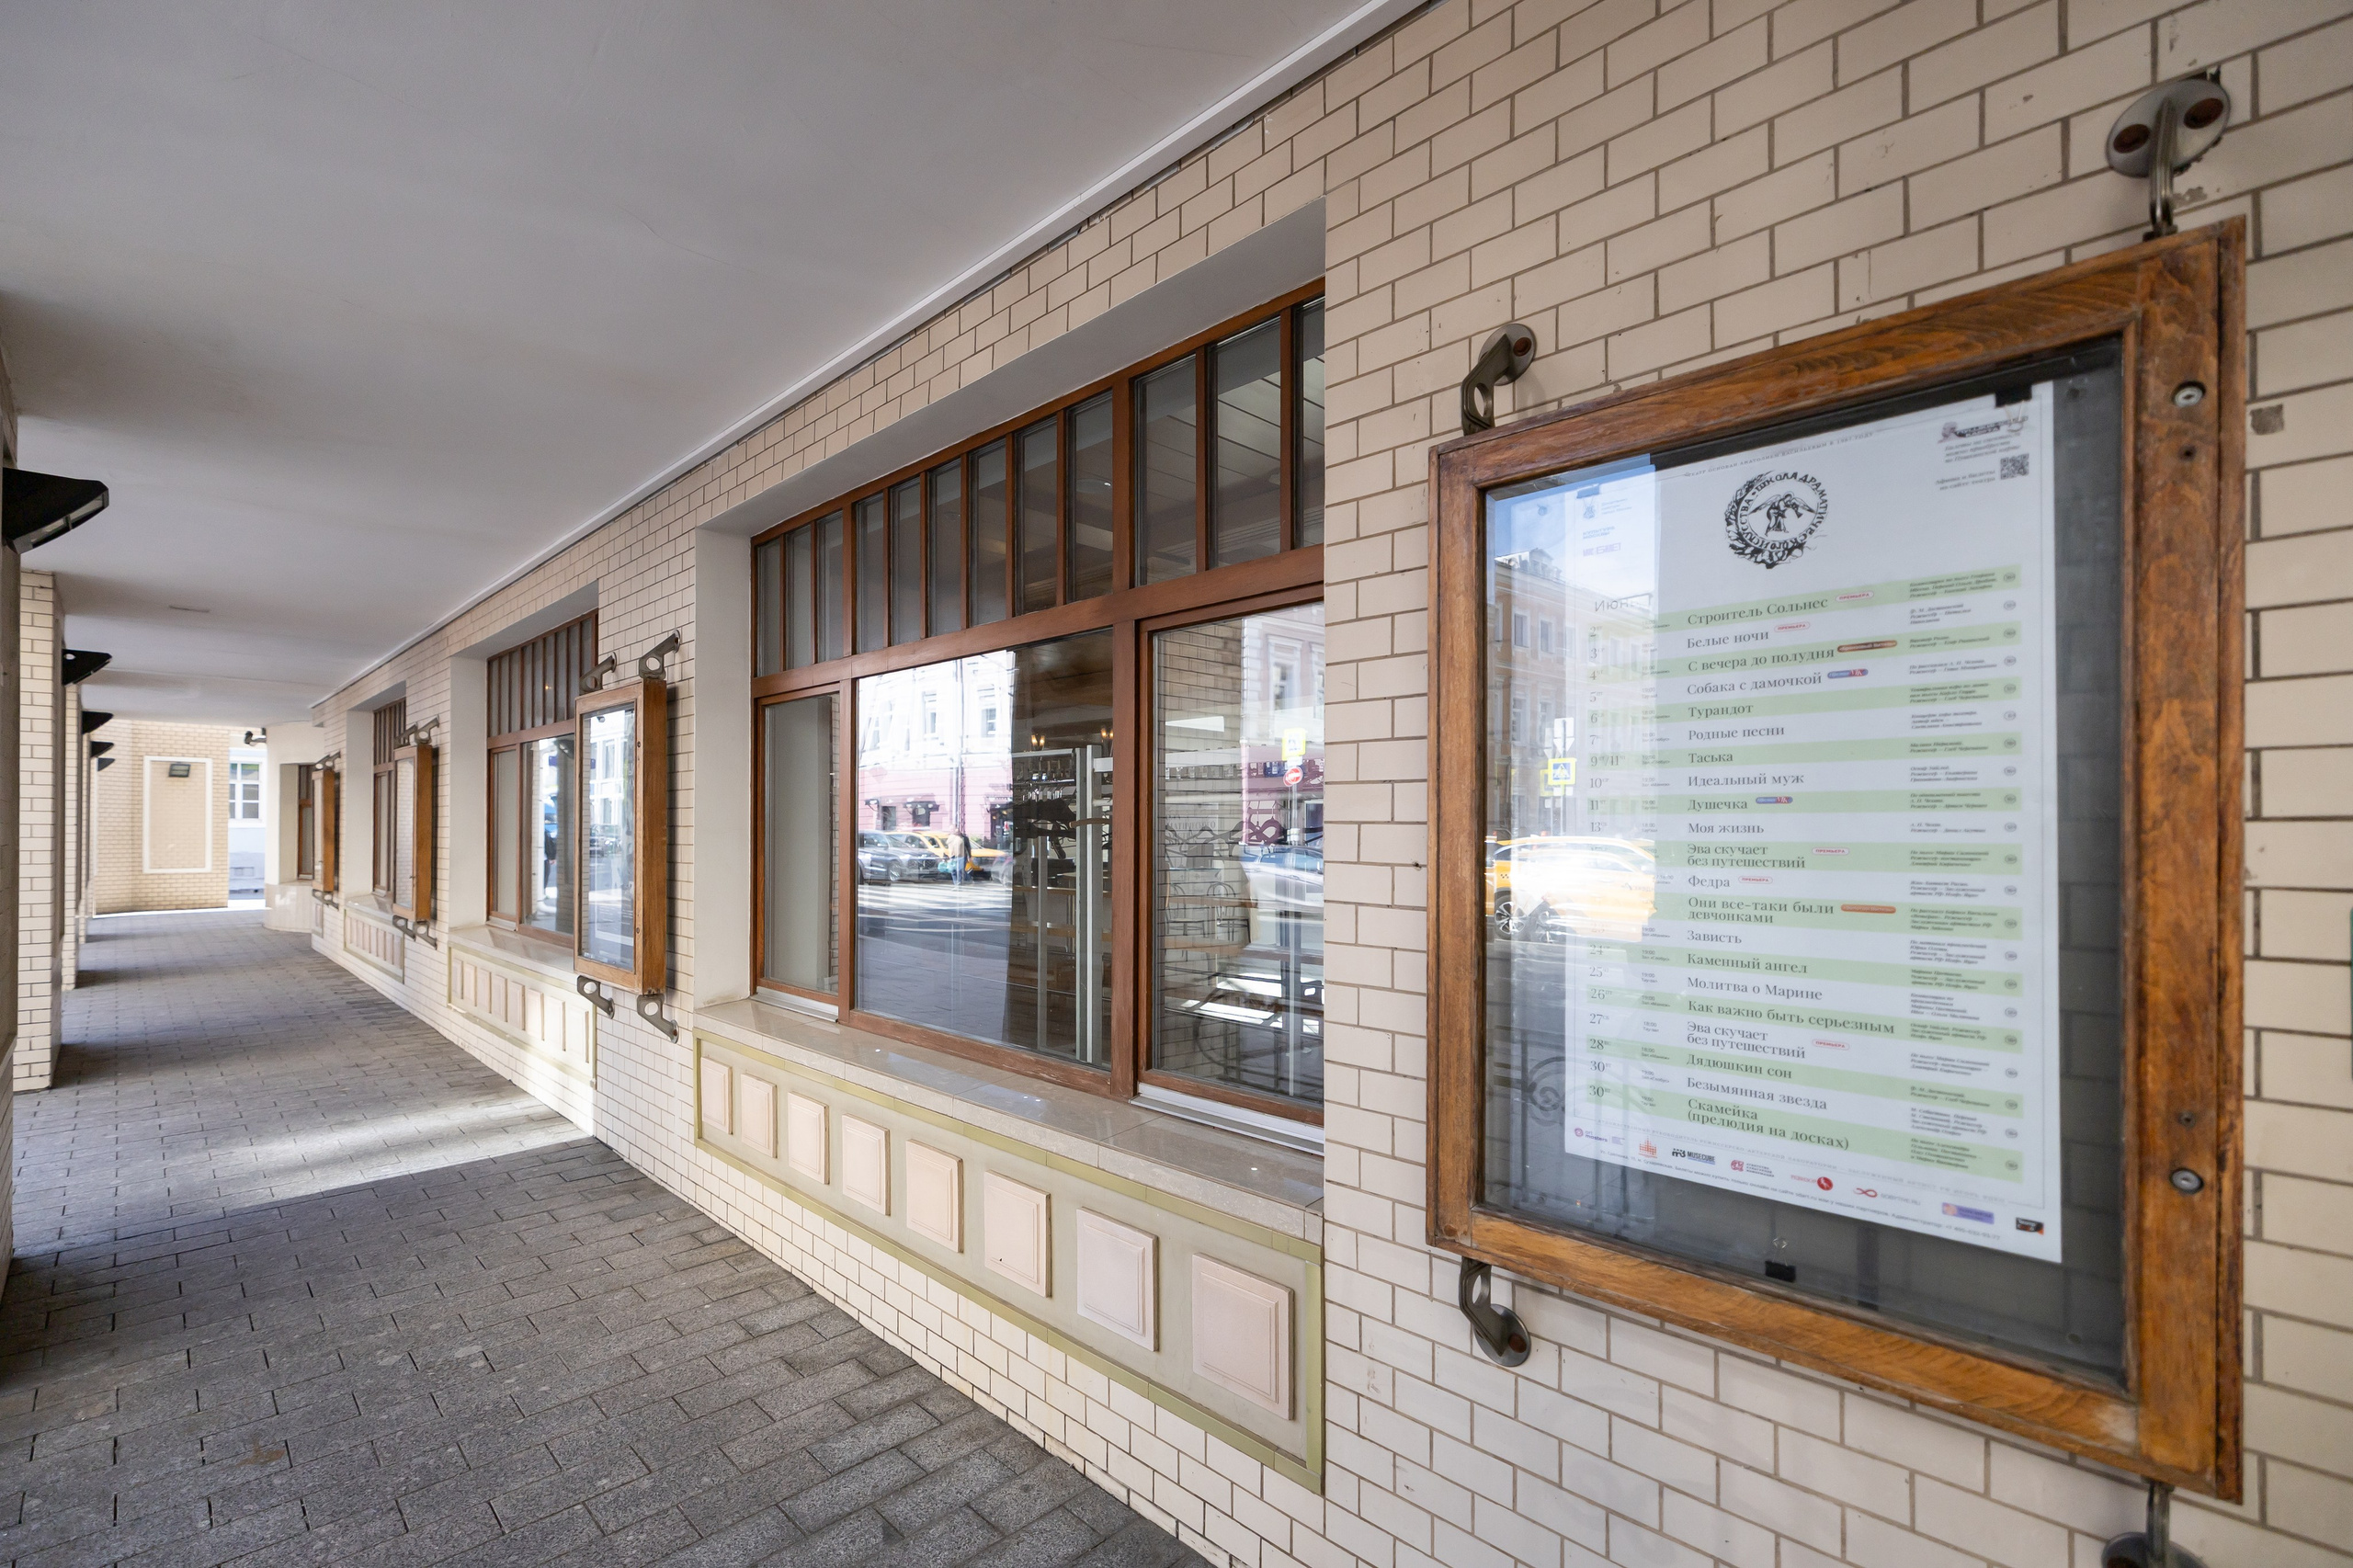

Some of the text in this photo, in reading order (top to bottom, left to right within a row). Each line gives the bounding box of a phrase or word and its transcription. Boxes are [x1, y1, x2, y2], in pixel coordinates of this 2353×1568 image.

[1708, 462, 1737, 473] ОСНОВАН
[1740, 453, 1779, 465] АНАТОЛИЕМ
[1755, 472, 1798, 493] ШКОЛА
[1688, 608, 1762, 625] Строитель
[1768, 599, 1827, 614] Сольнес
[1688, 637, 1729, 648] Белые
[1734, 632, 1768, 642] ночи
[1688, 650, 1834, 671] С вечера до полудня
[1688, 683, 1734, 694] Собака
[1750, 672, 1821, 690] дамочкой
[1590, 712, 1598, 724] 6
[1688, 706, 1753, 719] Турандот
[1689, 728, 1784, 740] Родные песни
[1688, 754, 1733, 763] Таська
[1590, 778, 1602, 789] 10
[1688, 773, 1803, 787] Идеальный муж
[1590, 800, 1599, 811] 11
[1688, 800, 1747, 812] Душечка
[1590, 822, 1601, 833] 13
[1688, 824, 1713, 833] Моя
[1688, 844, 1711, 854] Эва
[1714, 846, 1768, 857] скучает
[1688, 856, 1805, 869] без путешествий
[1688, 875, 1730, 889] Федра
[1688, 897, 1833, 914] Они все-таки были
[1688, 909, 1775, 923] девчонками
[1688, 930, 1742, 943] Зависть
[1589, 944, 1604, 956] 24
[1688, 954, 1806, 973] Каменный ангел
[1589, 966, 1603, 978] 25
[1590, 988, 1606, 1000] 26
[1688, 977, 1747, 993] Молитва
[1766, 984, 1822, 1000] Марине
[1589, 1013, 1603, 1025] 27
[1688, 1001, 1893, 1033] Как важно быть серьезным
[1688, 1022, 1846, 1049] Эва скучает ПРЕМЬЕРА
[1589, 1038, 1605, 1051] 28
[1688, 1033, 1804, 1058] без путешествий
[1590, 1060, 1606, 1073] 30
[1687, 1054, 1791, 1078] Дядюшкин сон
[1589, 1085, 1605, 1097] 30
[1688, 1077, 1826, 1109] Безымянная звезда
[1688, 1097, 1757, 1121] Скамейка
[1688, 1109, 1848, 1151] (прелюдия на досках)
[1585, 1134, 1608, 1142] masters
[1687, 1151, 1716, 1162] MUSECUBE
